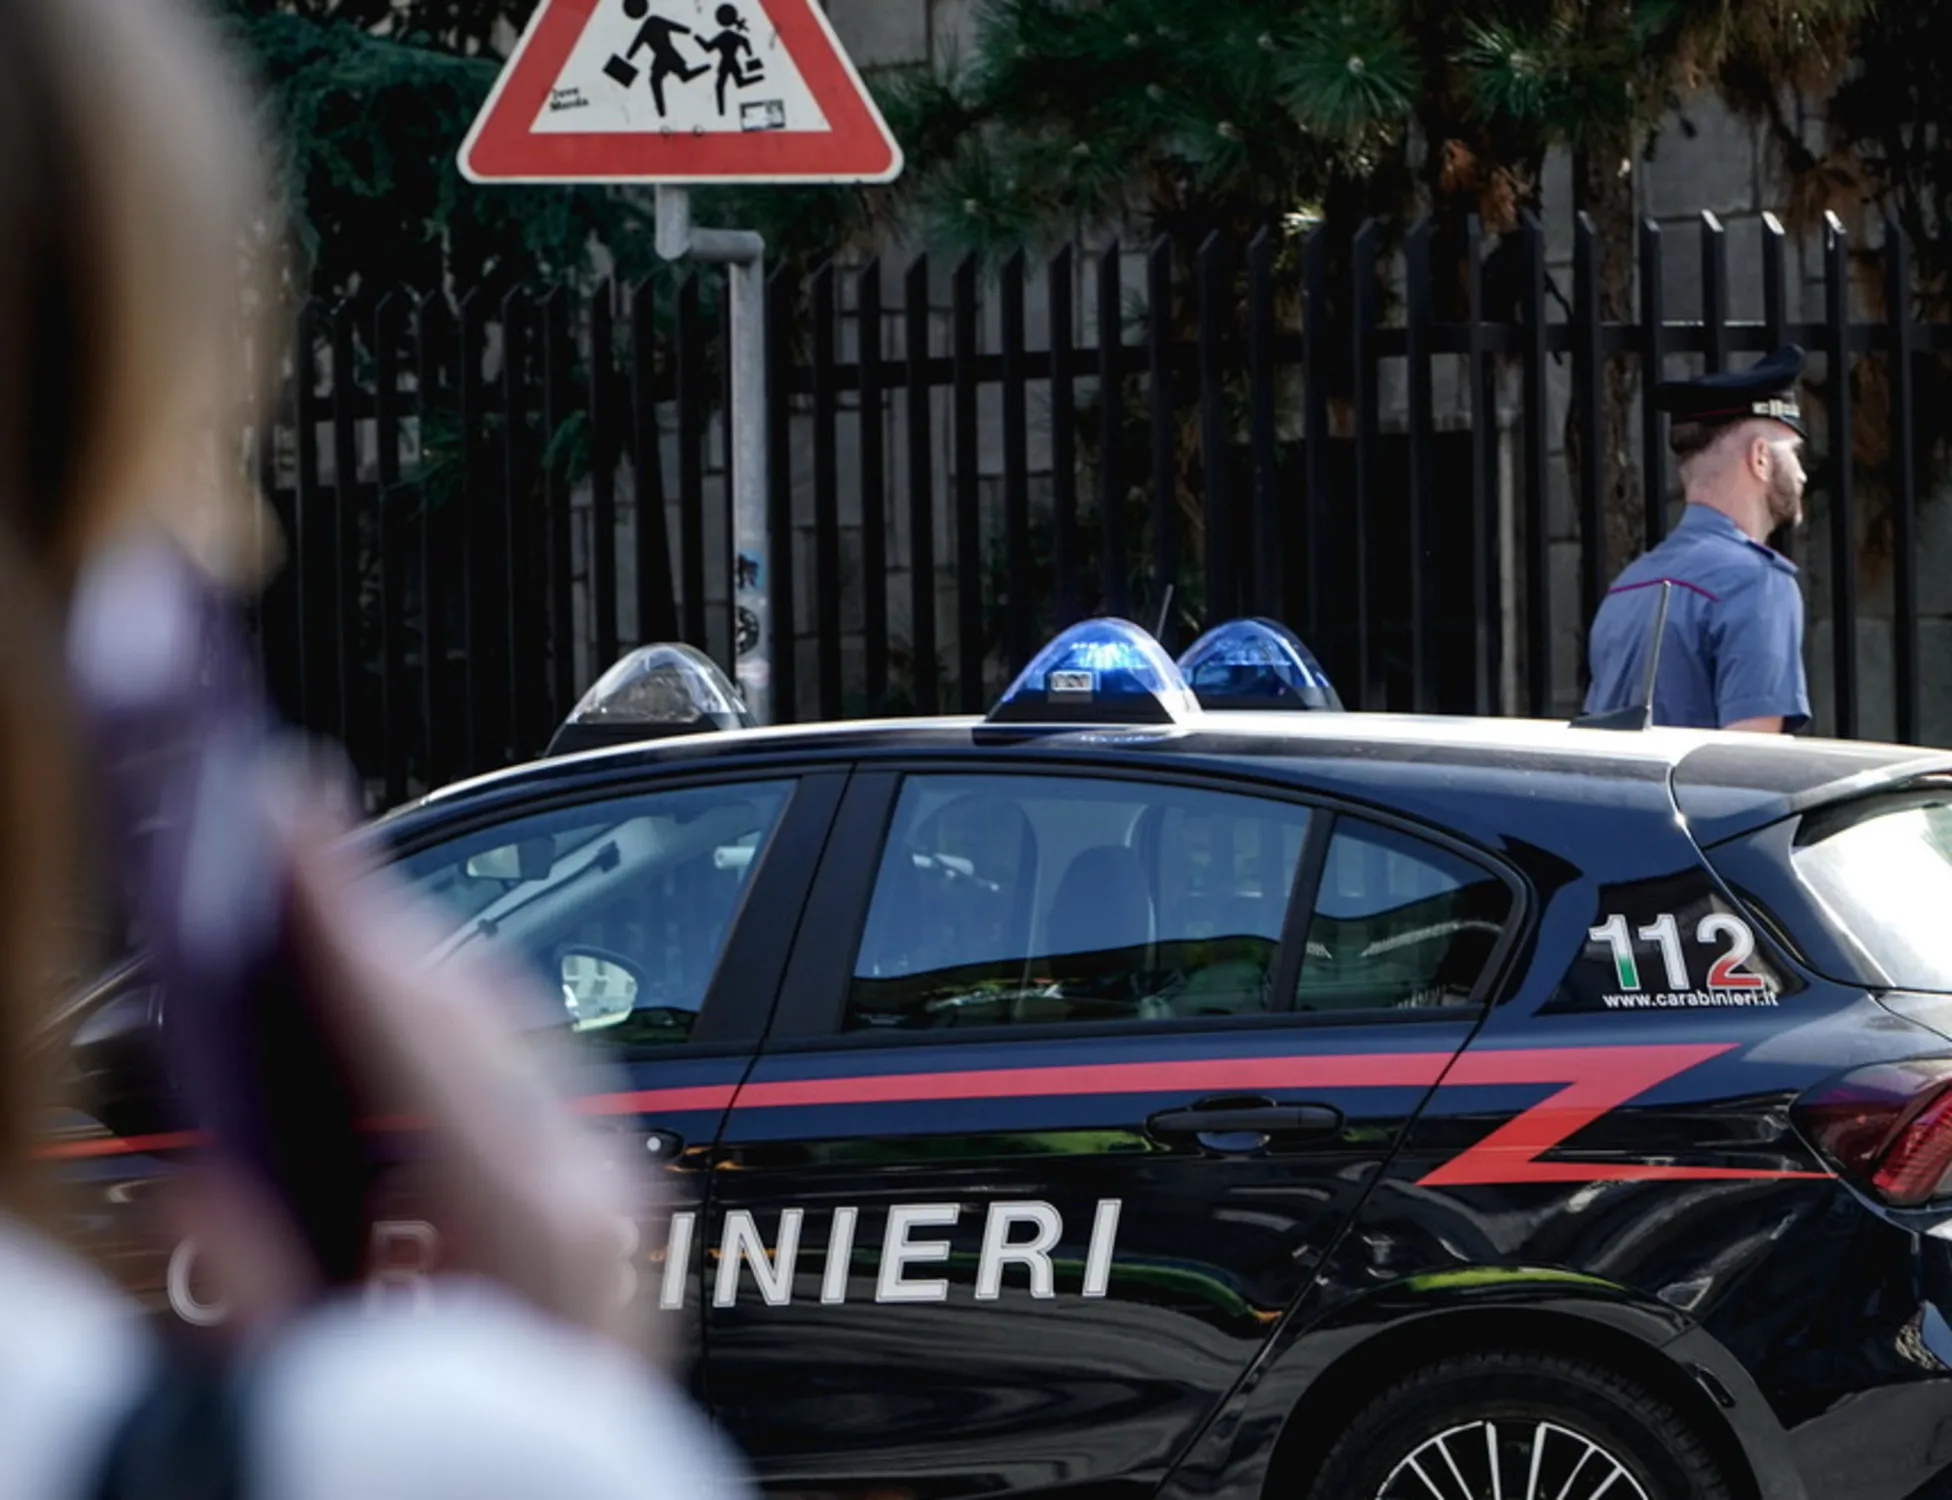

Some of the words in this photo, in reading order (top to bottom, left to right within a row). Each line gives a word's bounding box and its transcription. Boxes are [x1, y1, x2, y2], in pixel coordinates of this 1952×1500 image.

[1589, 913, 1765, 990] 112
[1602, 991, 1779, 1007] www.carabinieri.it
[167, 1199, 1122, 1326] CRINIERI
